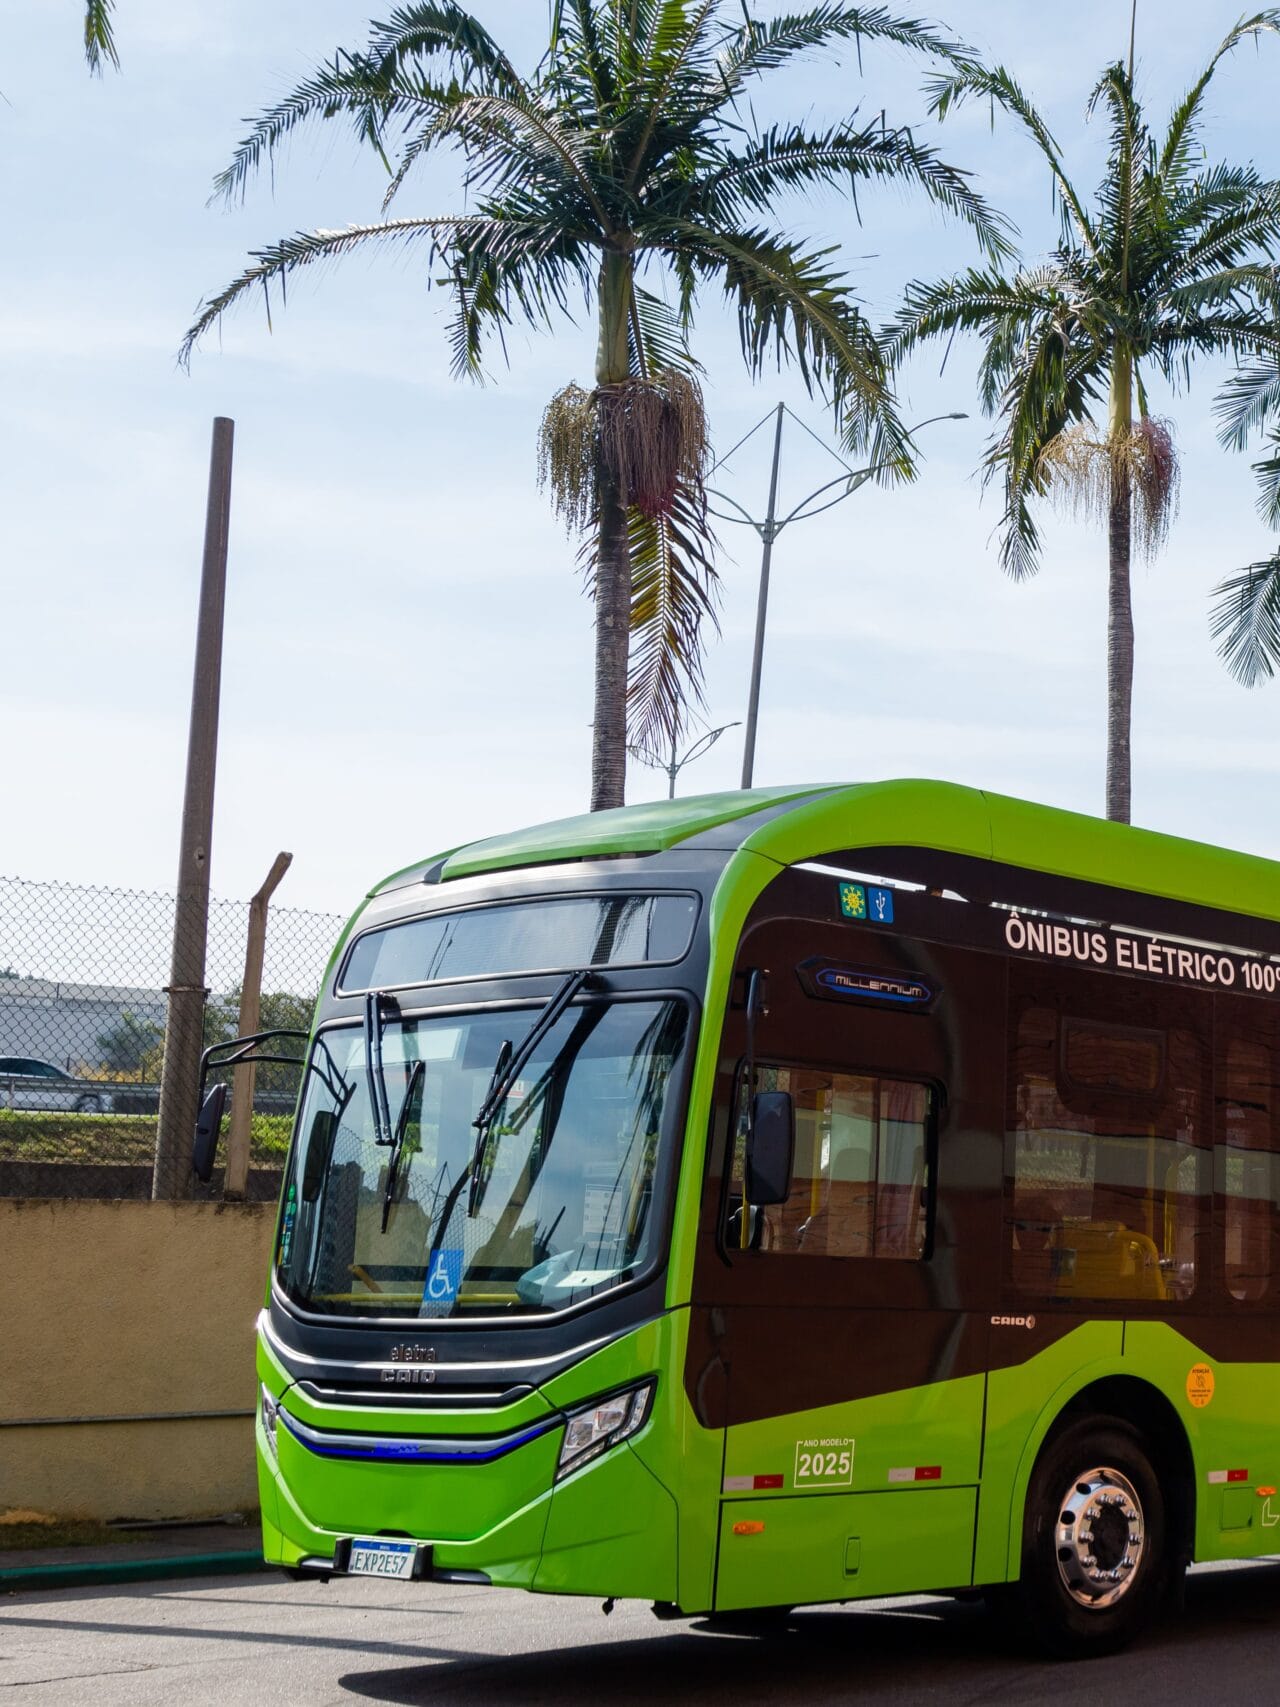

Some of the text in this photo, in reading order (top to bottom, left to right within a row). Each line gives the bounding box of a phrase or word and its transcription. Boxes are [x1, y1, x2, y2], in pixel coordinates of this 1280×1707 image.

[1005, 910, 1109, 964] ÔNIBUS
[1116, 936, 1235, 987] ELÉTRICO
[991, 1316, 1026, 1326] CAIO
[381, 1369, 436, 1383] CAIO
[803, 1438, 849, 1447] ANO MODELO
[798, 1452, 850, 1477] 2025
[354, 1551, 408, 1574] EXP2E57
